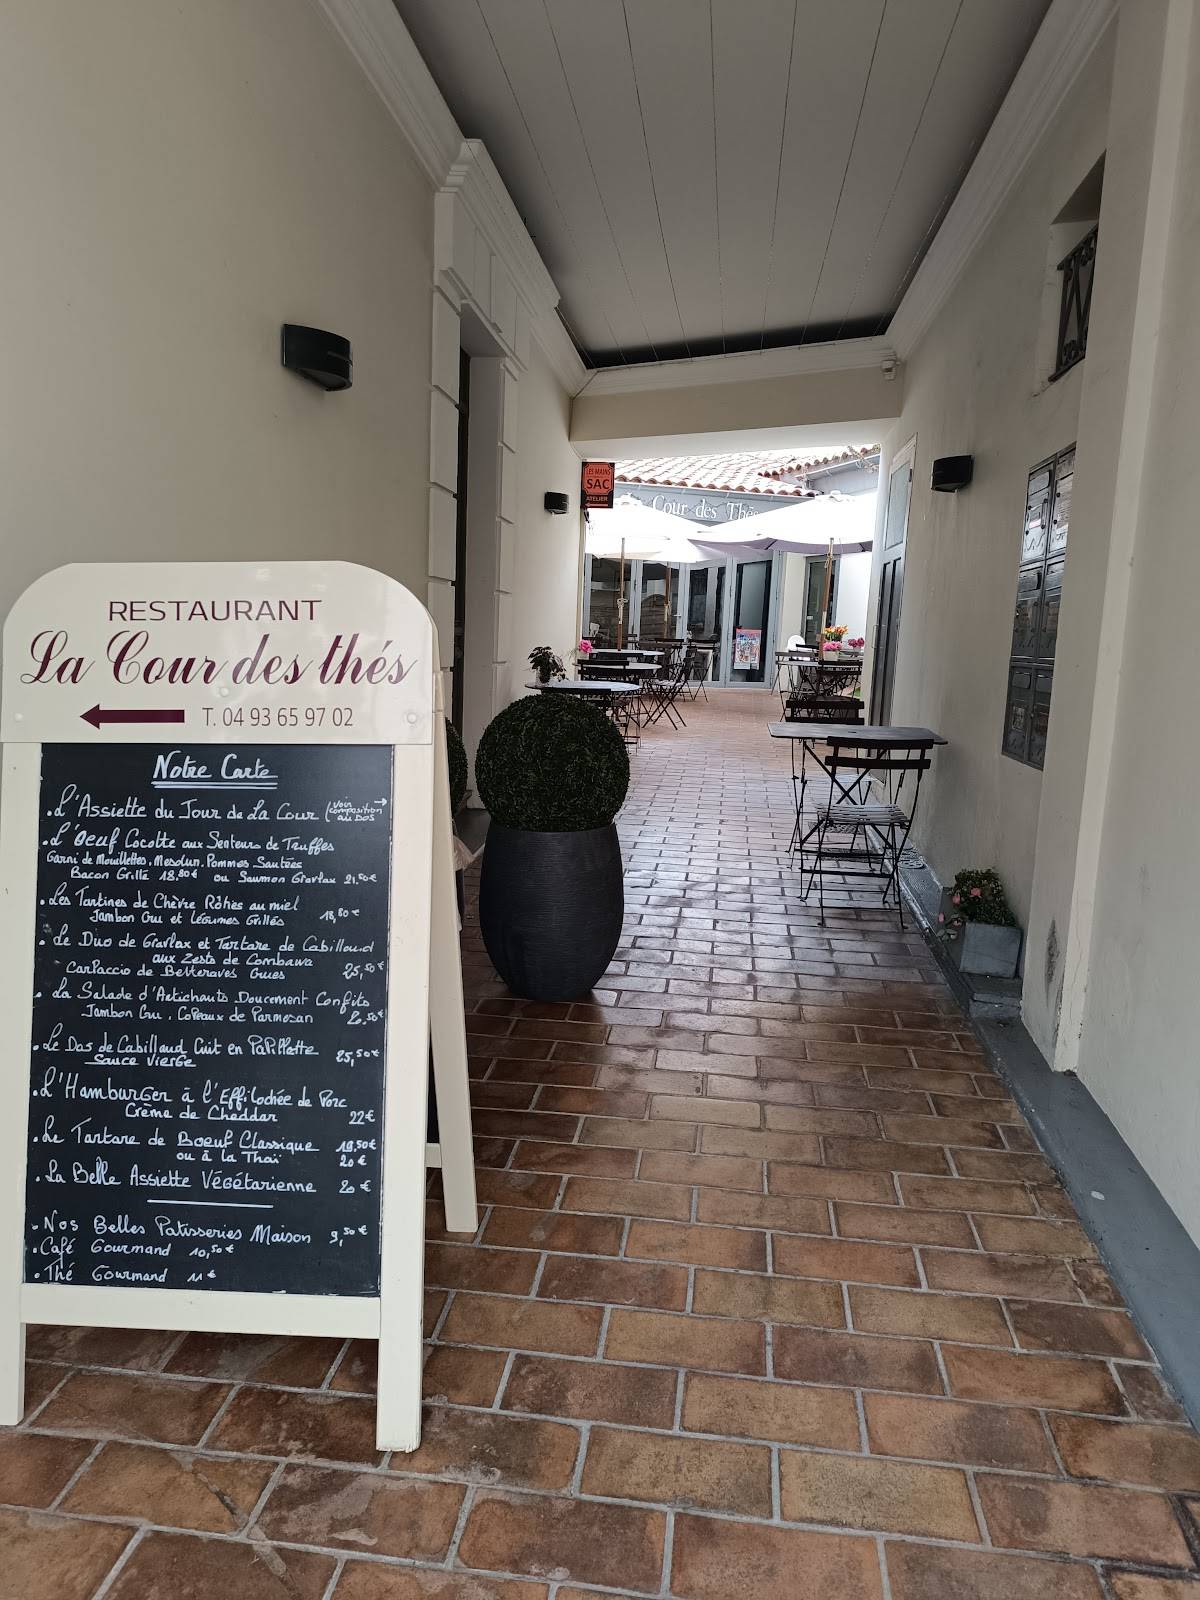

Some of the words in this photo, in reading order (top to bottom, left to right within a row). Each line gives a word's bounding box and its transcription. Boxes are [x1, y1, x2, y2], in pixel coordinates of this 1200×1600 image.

[586, 478, 610, 490] SAC
[652, 494, 688, 516] Cour
[695, 498, 717, 519] des
[108, 600, 323, 622] RESTAURANT
[20, 630, 96, 685] La
[106, 630, 229, 686] Cour
[232, 633, 313, 685] des
[318, 632, 419, 686] thés
[202, 707, 216, 727] T.
[222, 707, 245, 727] 04
[250, 707, 271, 727] 93
[277, 707, 298, 727] 65
[305, 707, 326, 727] 97
[331, 707, 354, 727] 02
[153, 750, 212, 779] Notre
[221, 753, 279, 779] Carte
